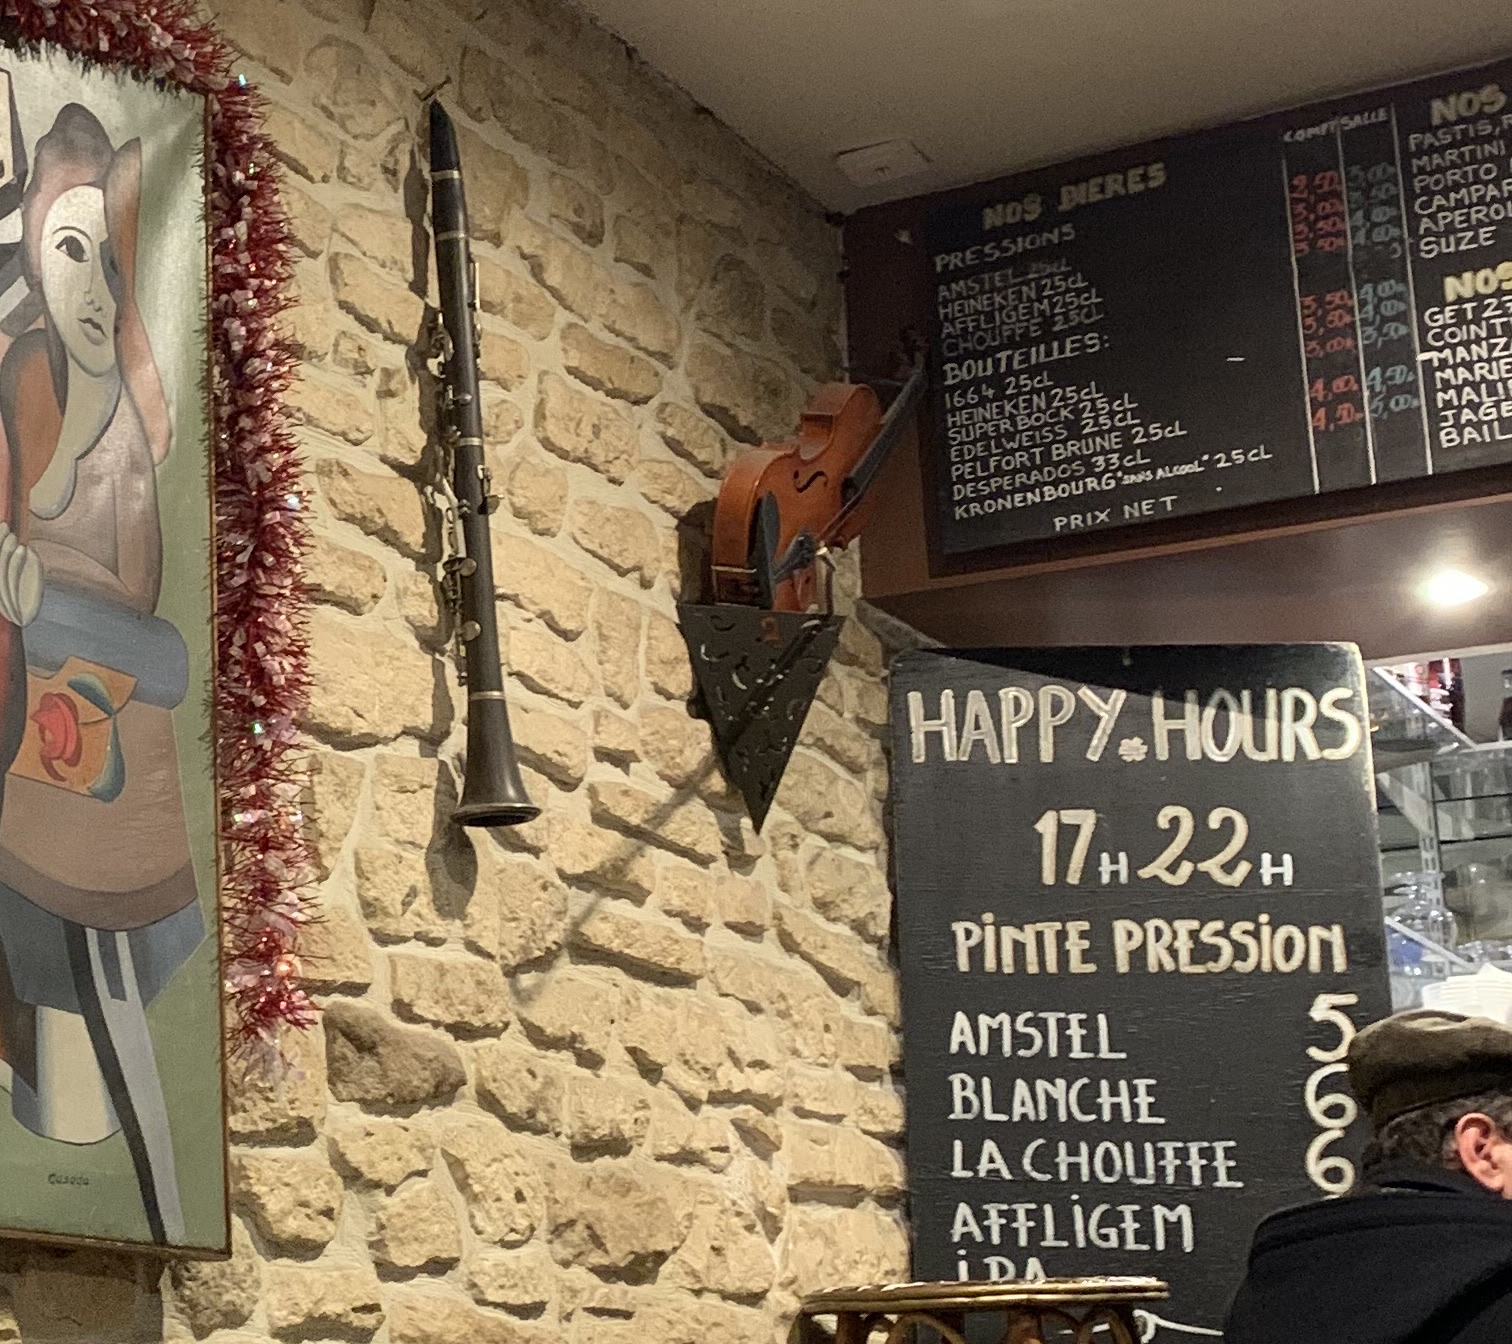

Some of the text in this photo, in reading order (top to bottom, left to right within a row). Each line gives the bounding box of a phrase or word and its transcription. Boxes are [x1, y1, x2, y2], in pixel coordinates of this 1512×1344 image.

[1431, 84, 1507, 126] NOS
[1412, 139, 1506, 174] MARTINI
[1414, 163, 1497, 193] PORTO
[982, 193, 1043, 230] NOS
[935, 222, 1076, 273] PRESSIONS
[1419, 225, 1497, 258] SUZE
[938, 268, 1024, 302] AMSTEL
[939, 282, 1037, 321] HEINEKEN
[1443, 261, 1512, 303] NOS
[941, 299, 1051, 338] AFFLIGEM
[1424, 302, 1478, 327] GET
[1426, 317, 1512, 347] COINT
[1431, 336, 1512, 367] MANZ
[944, 383, 995, 409] 1664
[947, 391, 1046, 428] HEINEKEN
[948, 419, 1014, 445] SUPER
[1016, 406, 1075, 430] BOCK
[950, 424, 1068, 462] EDELWEISS
[951, 447, 1045, 482] PELFORT
[1050, 431, 1123, 461] BRUNE
[953, 460, 1086, 500] DESPERADOS
[954, 472, 1117, 521] KRONENBOURG
[1053, 495, 1179, 532] PRIX NET
[1151, 687, 1363, 763] HOURS
[949, 993, 1359, 1063] AMSTEL 5
[947, 1062, 1359, 1130] BLANCHE 6
[950, 1128, 1357, 1195] LA CHOUFFE 6
